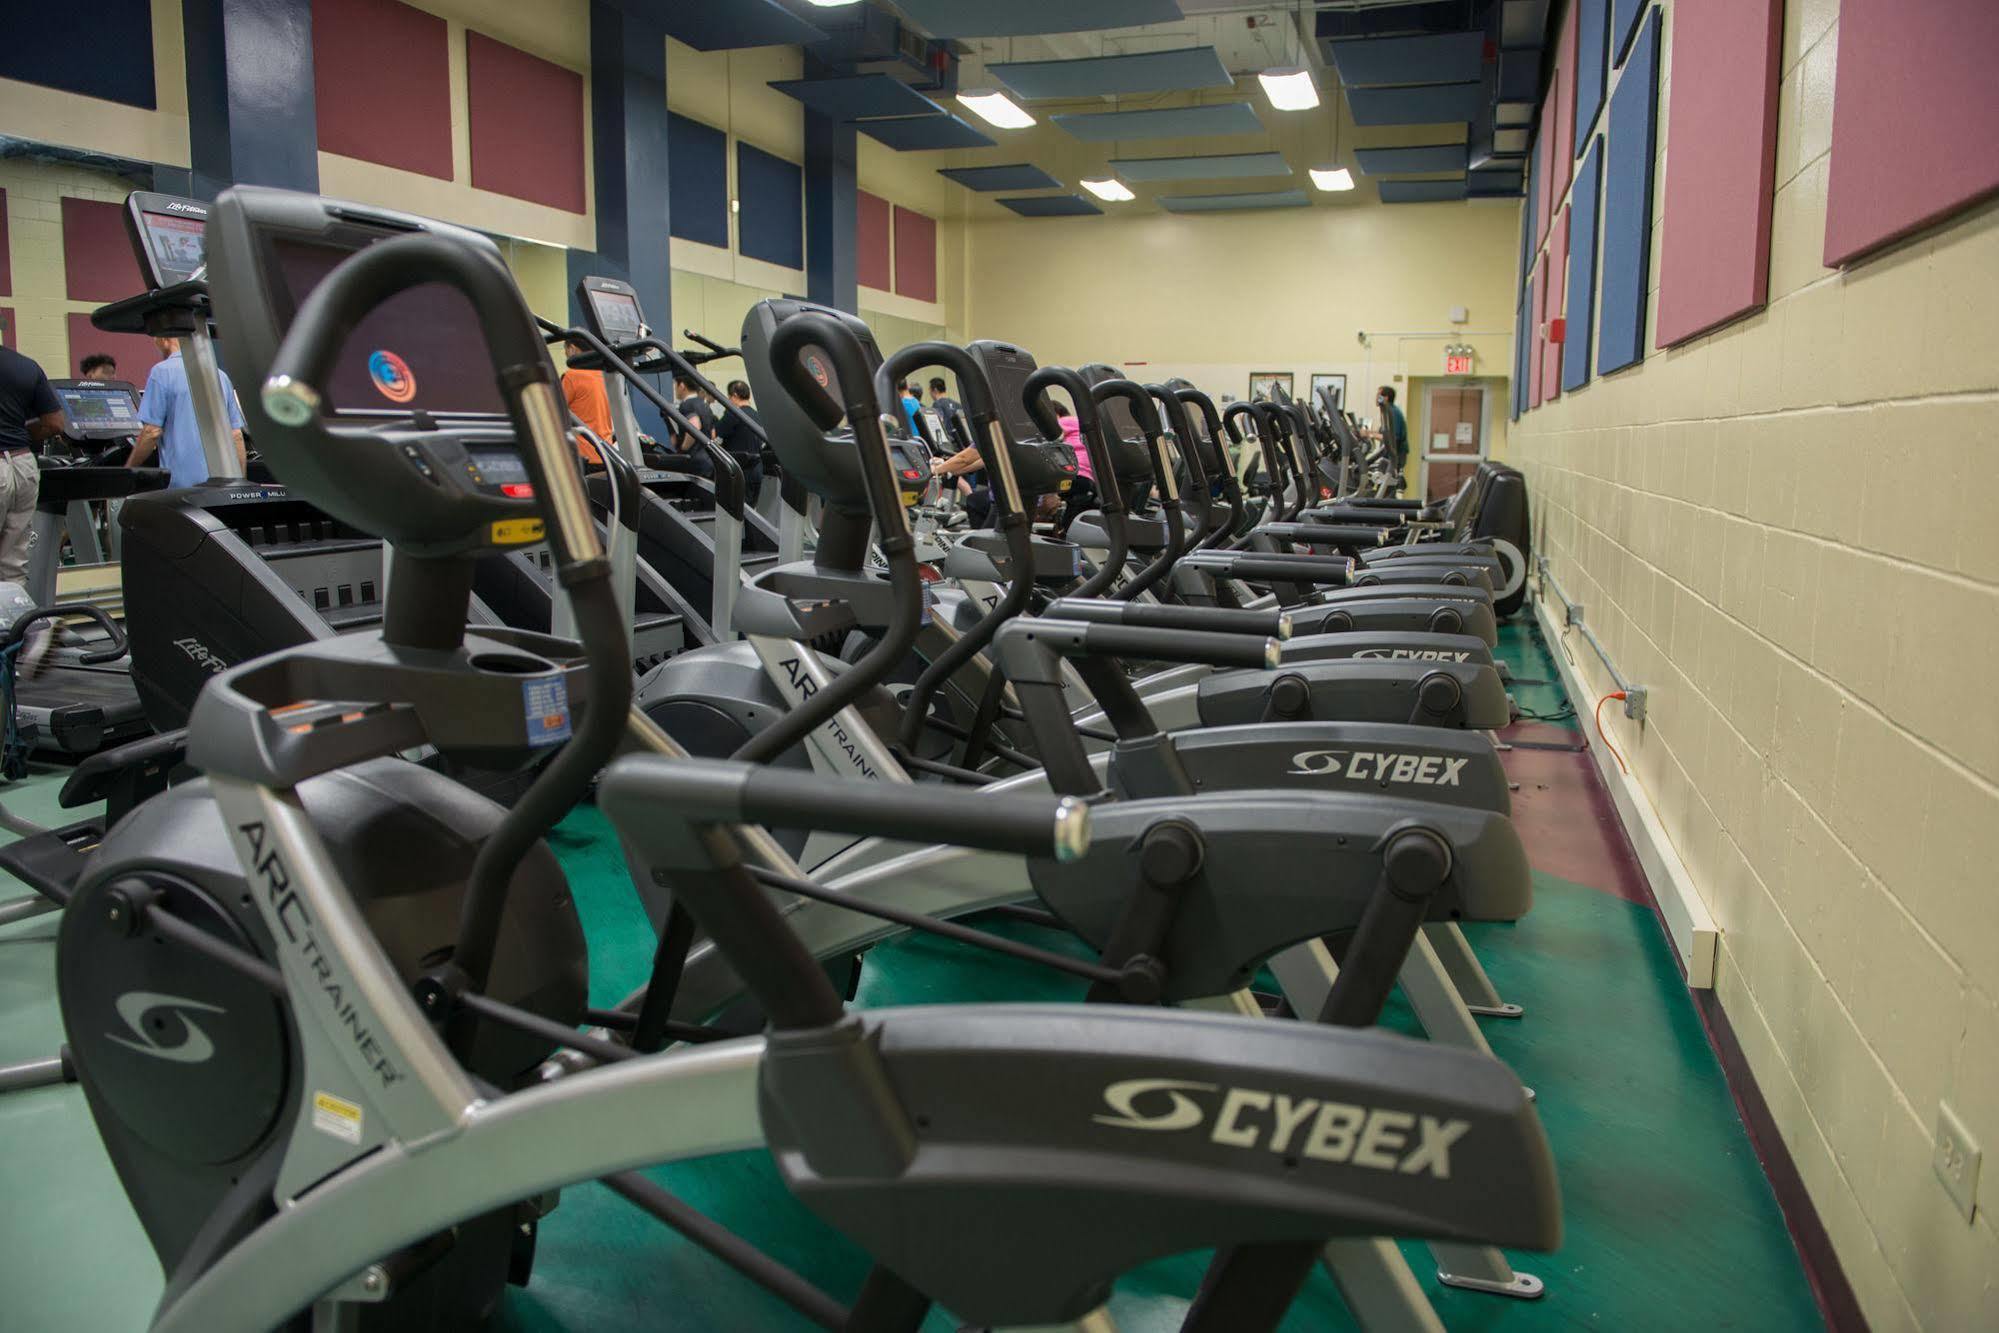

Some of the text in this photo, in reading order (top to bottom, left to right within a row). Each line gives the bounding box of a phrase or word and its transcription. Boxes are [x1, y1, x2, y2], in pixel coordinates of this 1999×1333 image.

[1447, 355, 1470, 372] EXIT
[230, 492, 262, 500] POWER
[1345, 751, 1469, 787] CYBEX
[1210, 1087, 1472, 1179] CYBEX
